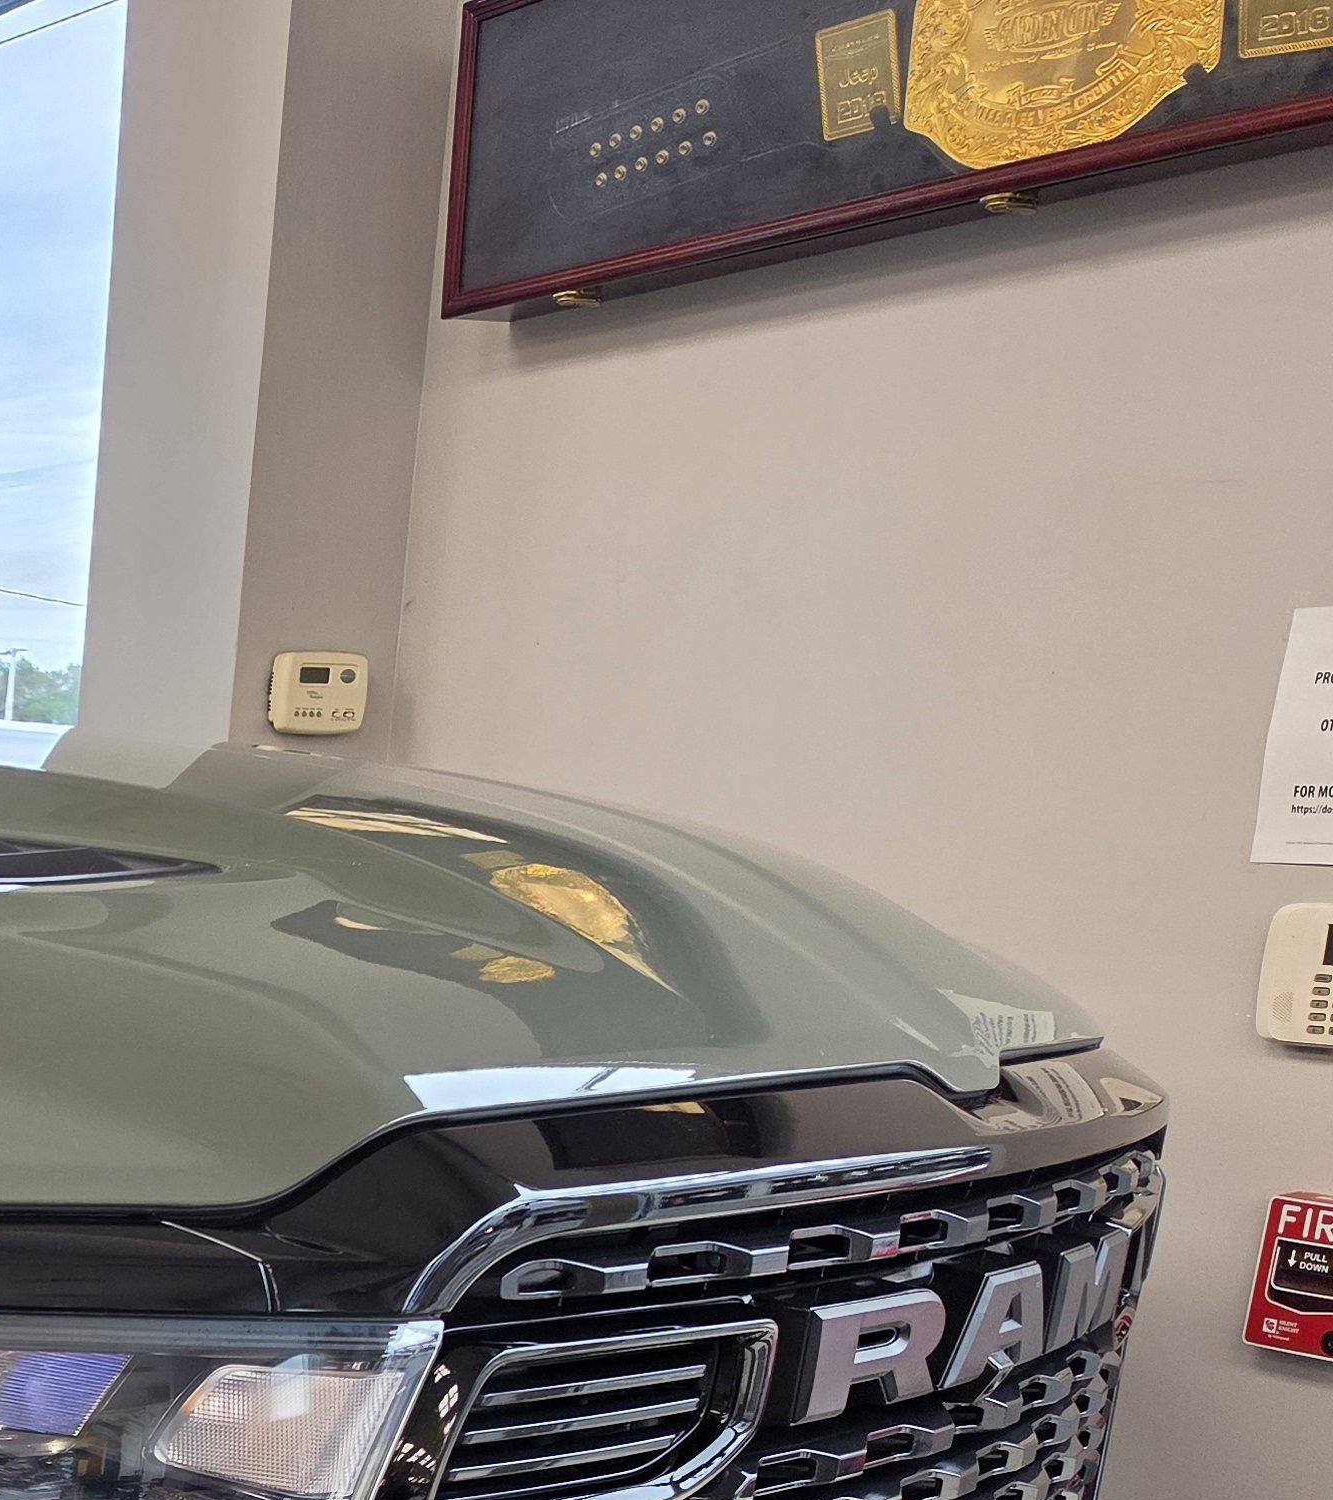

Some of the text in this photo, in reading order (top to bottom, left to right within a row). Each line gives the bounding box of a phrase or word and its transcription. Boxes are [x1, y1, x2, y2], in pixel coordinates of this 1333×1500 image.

[839, 65, 879, 89] Jeep
[1293, 785, 1316, 798] FOR
[1303, 1251, 1329, 1264] PULL
[1299, 1261, 1330, 1274] DOWN
[790, 1222, 1133, 1426] RAM
